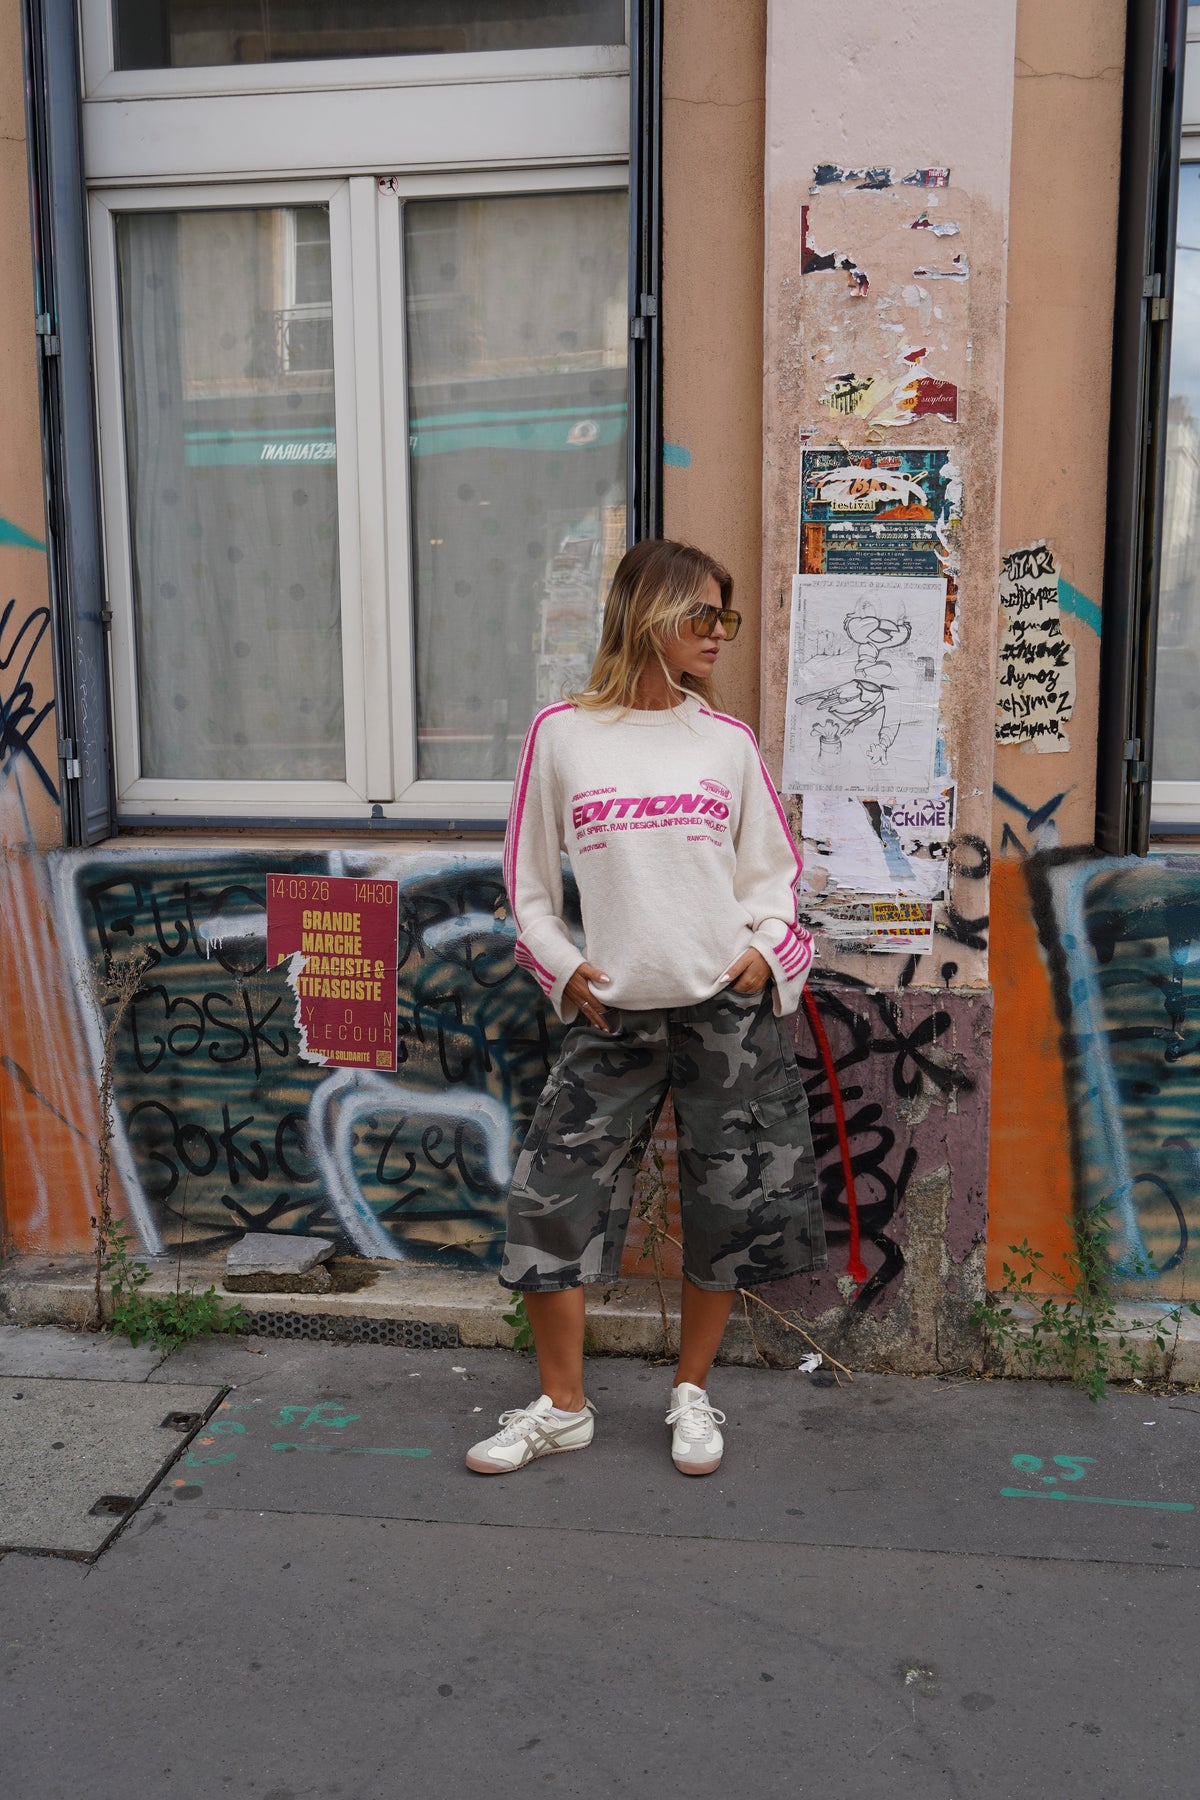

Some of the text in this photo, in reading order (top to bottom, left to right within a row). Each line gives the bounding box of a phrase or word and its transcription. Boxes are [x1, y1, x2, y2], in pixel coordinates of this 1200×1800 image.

[832, 500, 876, 512] festival
[610, 823, 628, 832] RAW
[630, 820, 660, 830] DESIGN.
[660, 817, 702, 828] UNFINISHED
[703, 818, 728, 833] PROJECT
[892, 812, 946, 826] CRIME
[354, 883, 394, 905] 14H30
[302, 910, 361, 933] GRANDE
[301, 932, 362, 956] MARCHE
[277, 953, 386, 980] AIRACISTE &
[296, 977, 382, 1002] TIFASCISTE
[312, 1023, 392, 1044] LECOUR
[336, 1050, 371, 1063] SOLIDARITÉ
